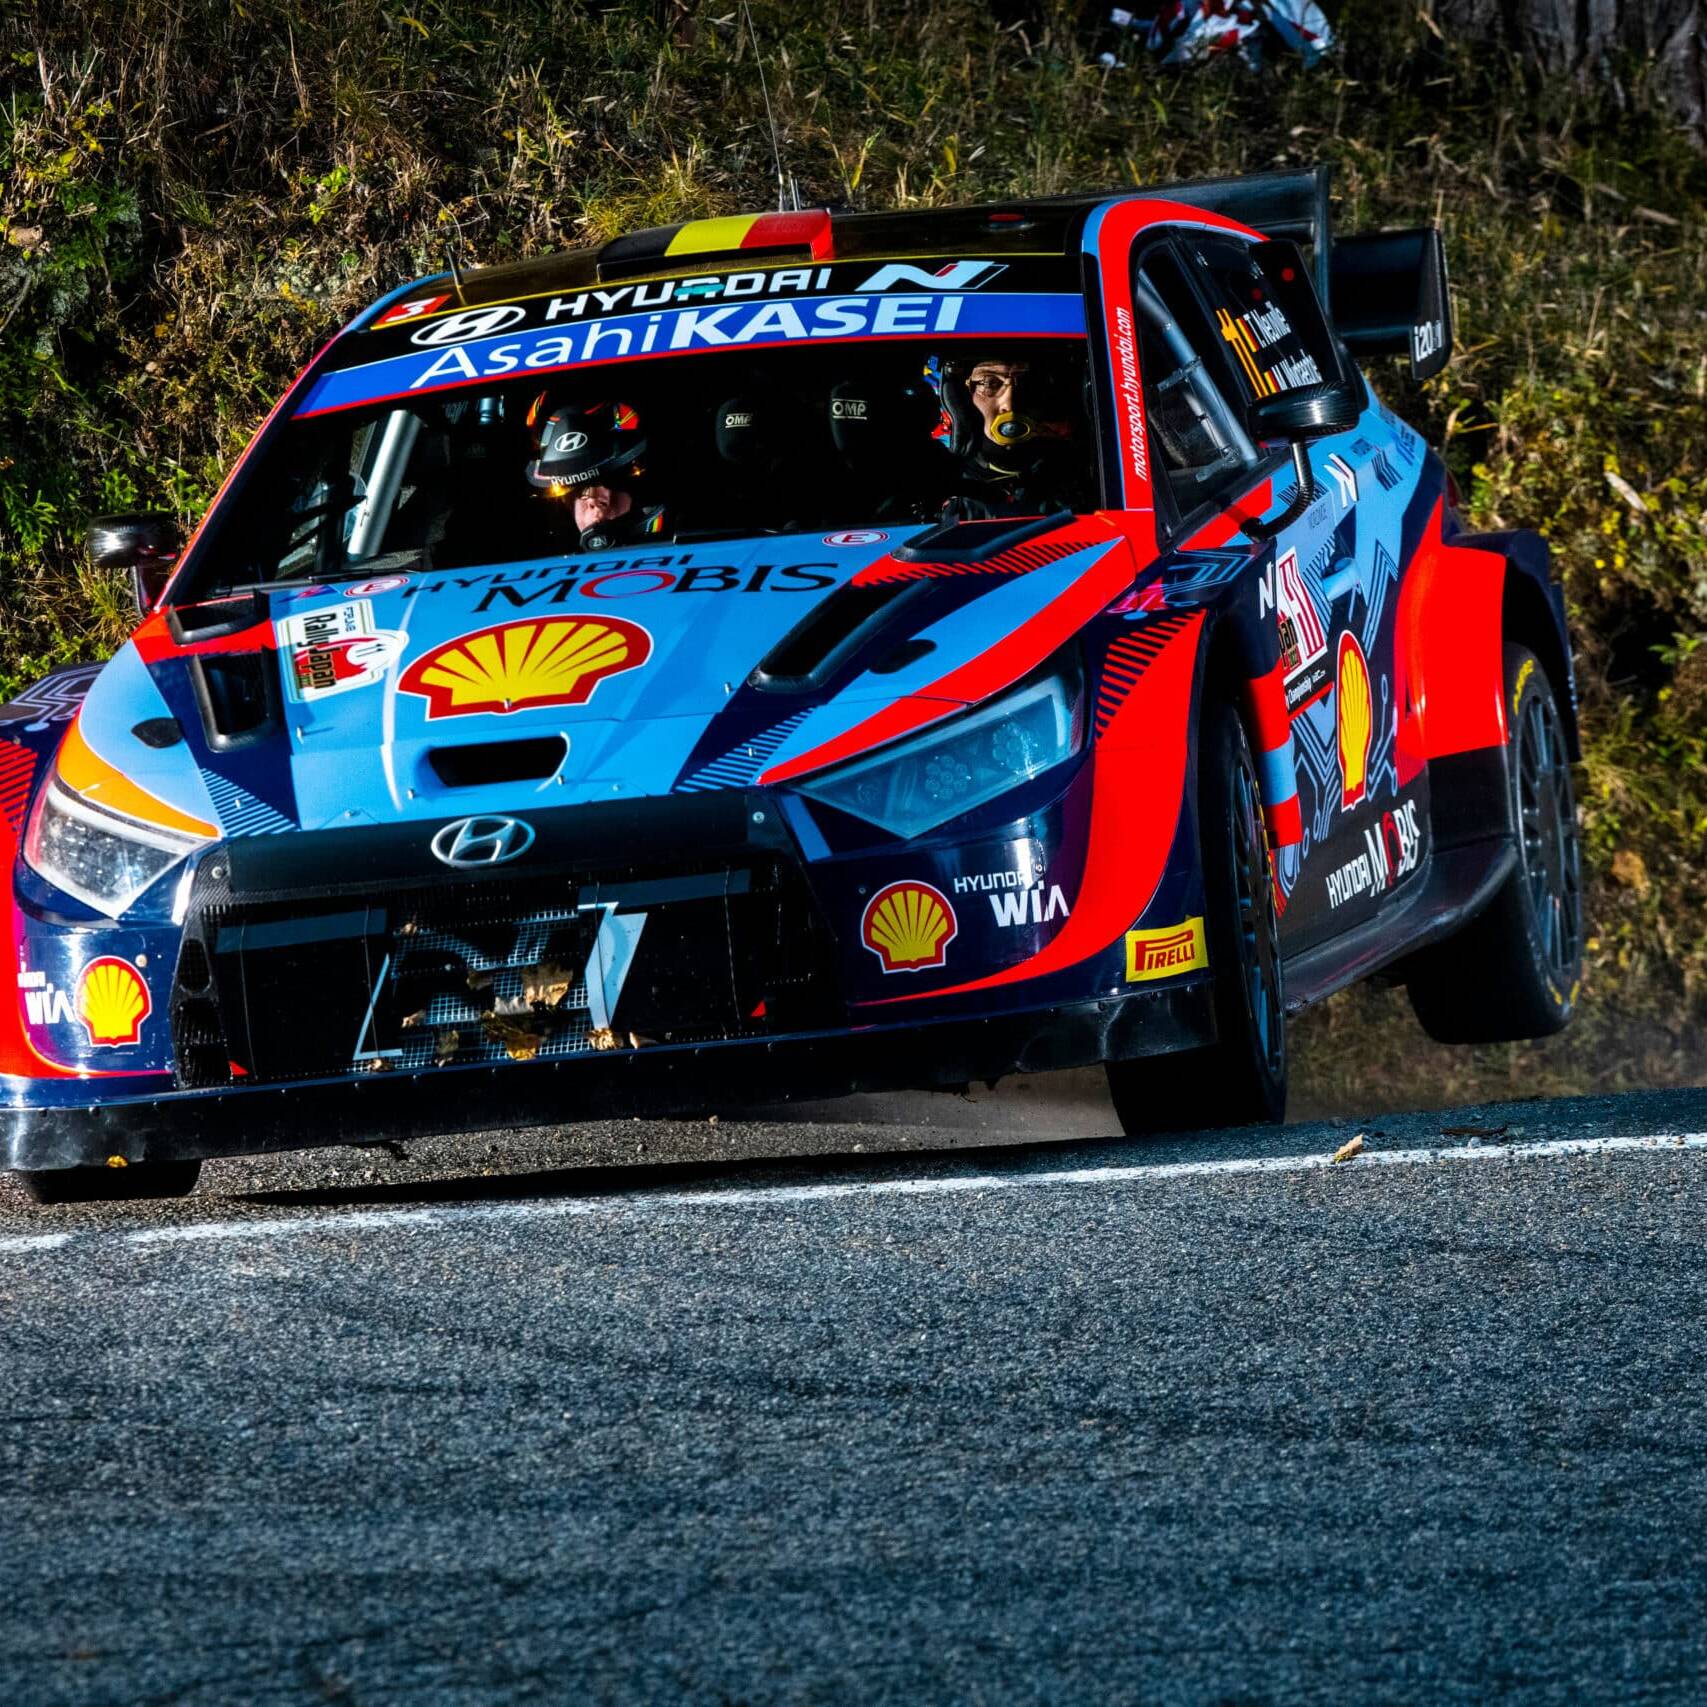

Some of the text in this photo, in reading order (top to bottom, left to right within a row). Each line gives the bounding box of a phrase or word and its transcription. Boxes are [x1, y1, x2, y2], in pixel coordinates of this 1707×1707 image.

[384, 298, 437, 322] 3
[545, 268, 832, 320] HYUNDAI
[832, 401, 867, 416] OMP
[1114, 306, 1148, 481] motorsport.hyundai.com
[402, 553, 695, 599] HYUNDAI
[470, 562, 838, 614] MOBIS
[296, 612, 342, 689] Rally Japan
[1326, 799, 1421, 909] HYUNDAI MOBIS
[1134, 929, 1196, 971] PIRELLI
